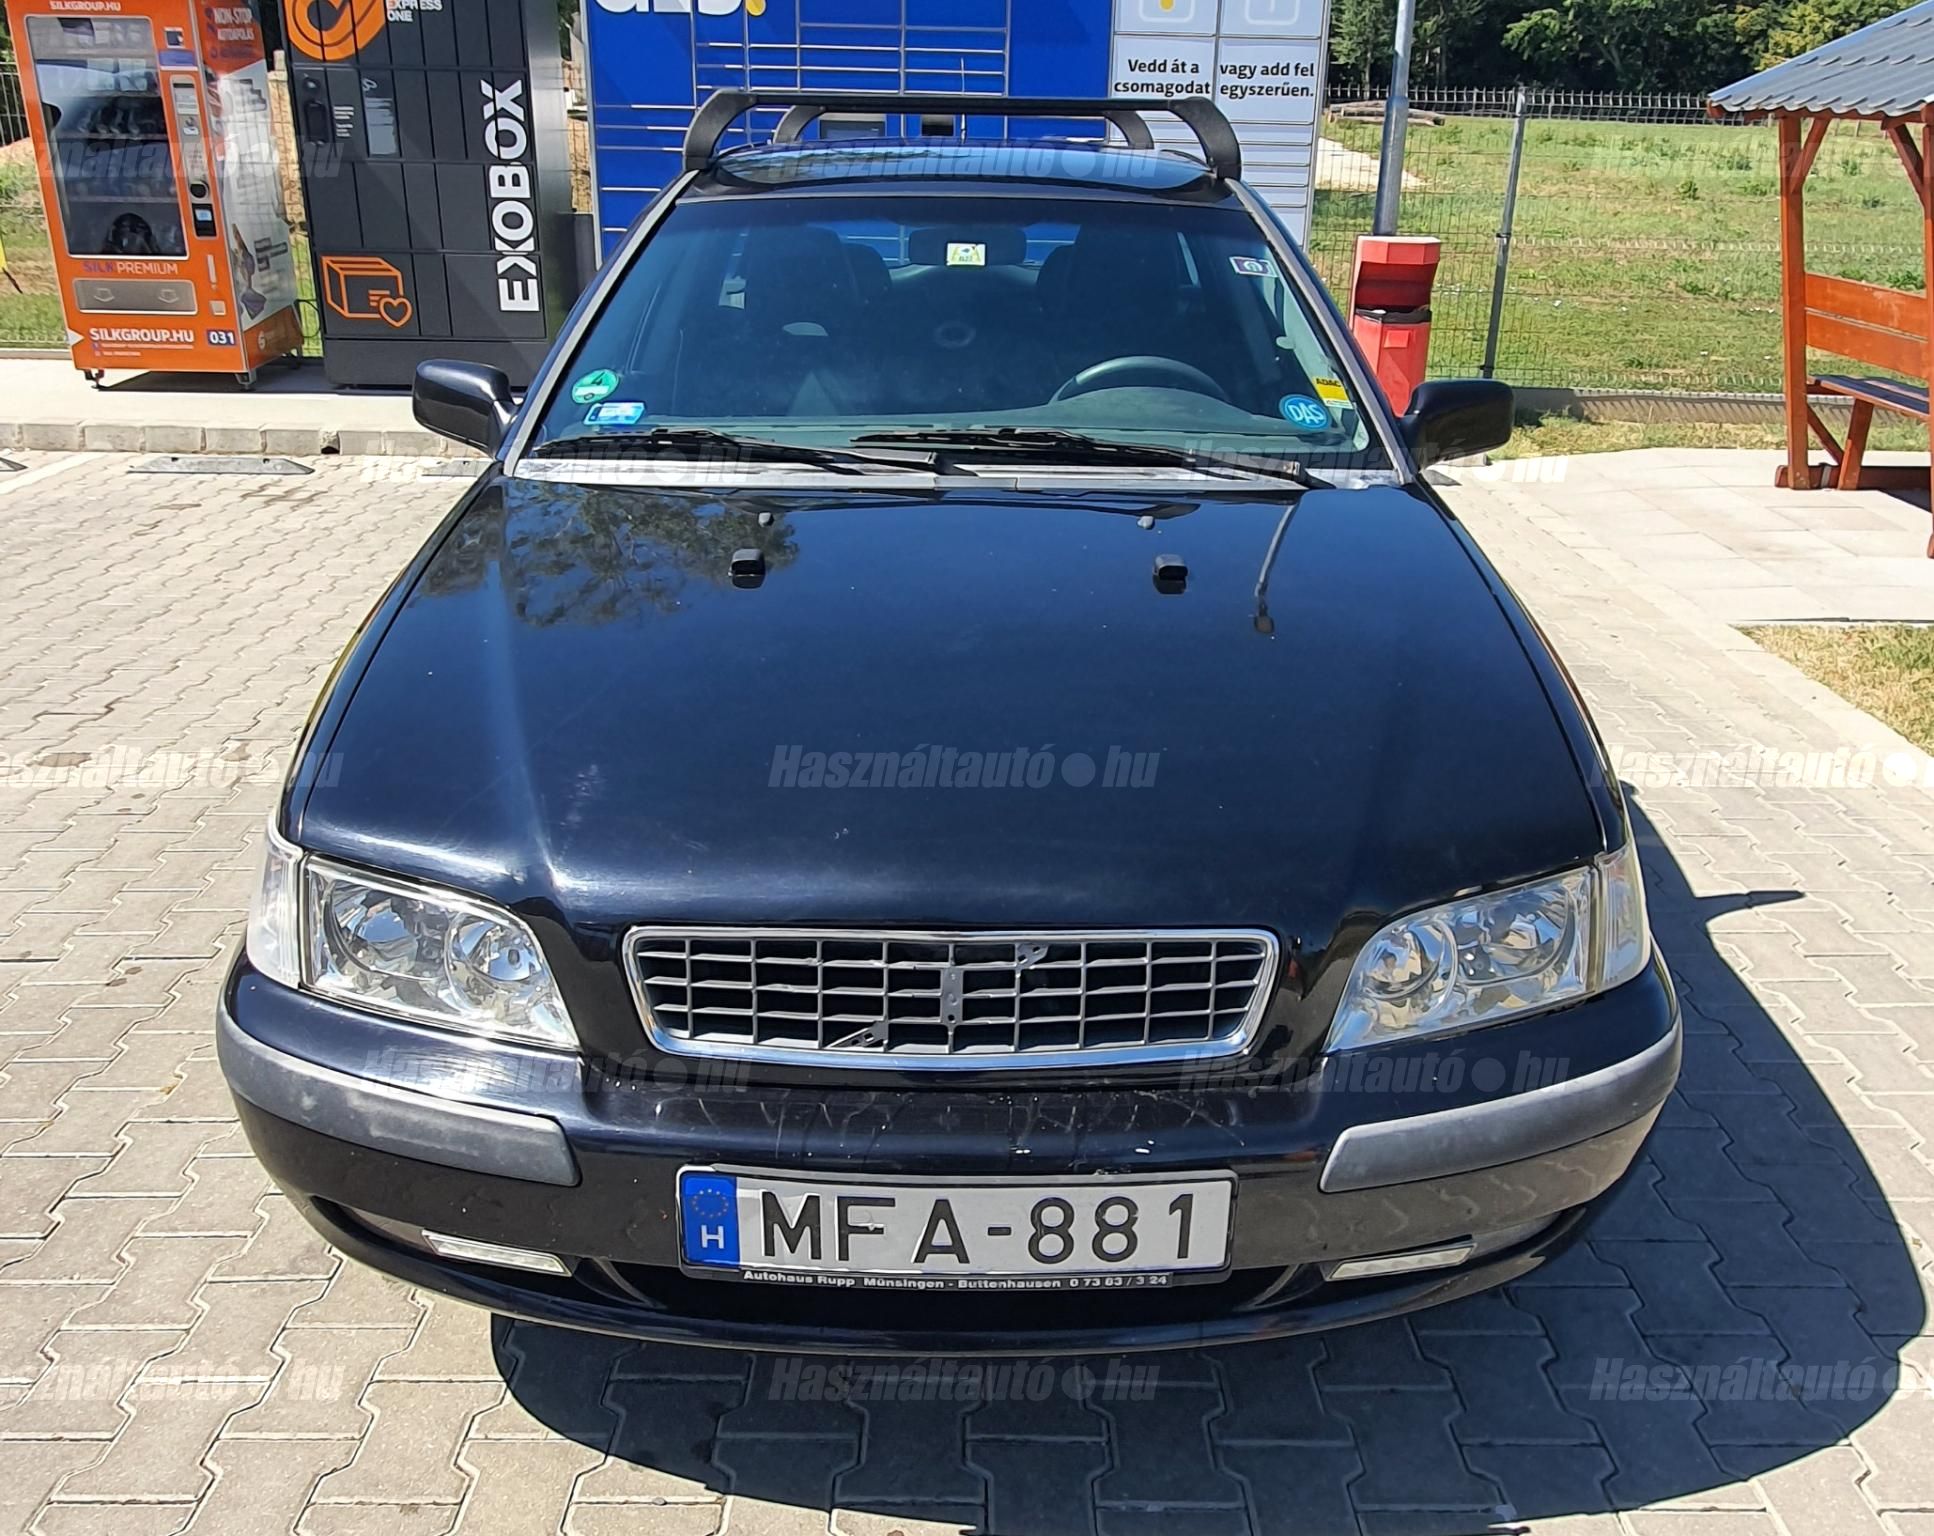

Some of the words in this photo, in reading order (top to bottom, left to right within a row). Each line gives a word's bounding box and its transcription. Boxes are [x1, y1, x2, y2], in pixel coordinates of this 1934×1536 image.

[387, 10, 413, 22] ONE
[1128, 59, 1167, 73] Vedd
[1171, 59, 1186, 74] át
[1190, 62, 1199, 74] a
[1220, 64, 1257, 79] vagy
[1260, 62, 1290, 76] add
[1294, 63, 1314, 77] fel
[1114, 81, 1210, 97] csomagodat
[1220, 82, 1314, 99] egyszerűen.
[480, 79, 540, 312] EXOBOX
[117, 262, 178, 274] PREMIUM
[89, 328, 194, 342] SILKGROUP.HU
[209, 331, 235, 344] 031
[1288, 402, 1323, 424] DAS
[761, 1191, 1195, 1264] MFA-881
[700, 1225, 725, 1250] H
[744, 1271, 813, 1283] Autohaus
[817, 1276, 855, 1287] Rupp
[864, 1278, 944, 1289] Münsingen
[958, 1279, 1061, 1289] Buttenhausen
[1149, 1276, 1167, 1285] 24
